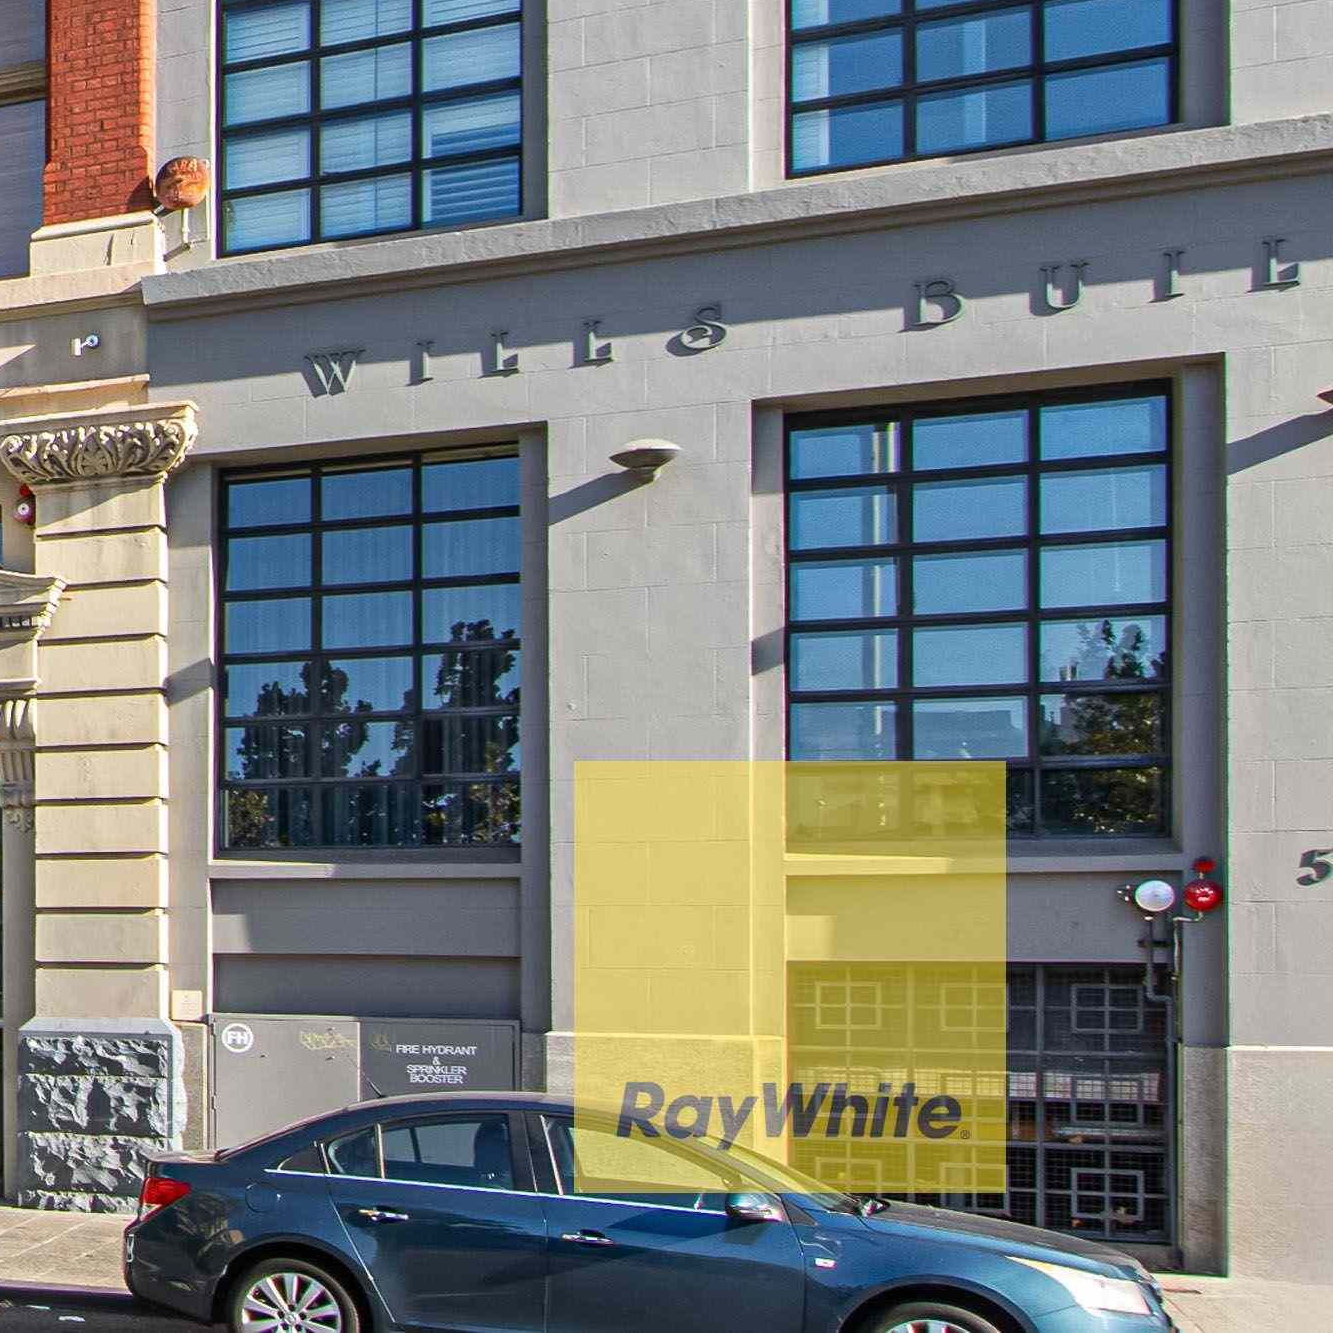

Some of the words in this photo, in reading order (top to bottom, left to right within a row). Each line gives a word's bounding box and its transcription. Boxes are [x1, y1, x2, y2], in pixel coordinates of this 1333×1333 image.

[303, 304, 728, 397] WILLS
[911, 238, 1301, 326] BUIL
[227, 1030, 247, 1045] FH
[396, 1044, 419, 1055] FIRE
[422, 1045, 477, 1055] HYDRANT
[433, 1056, 440, 1065] &
[406, 1065, 467, 1076] SPRINKLER
[410, 1074, 463, 1084] BOOSTER
